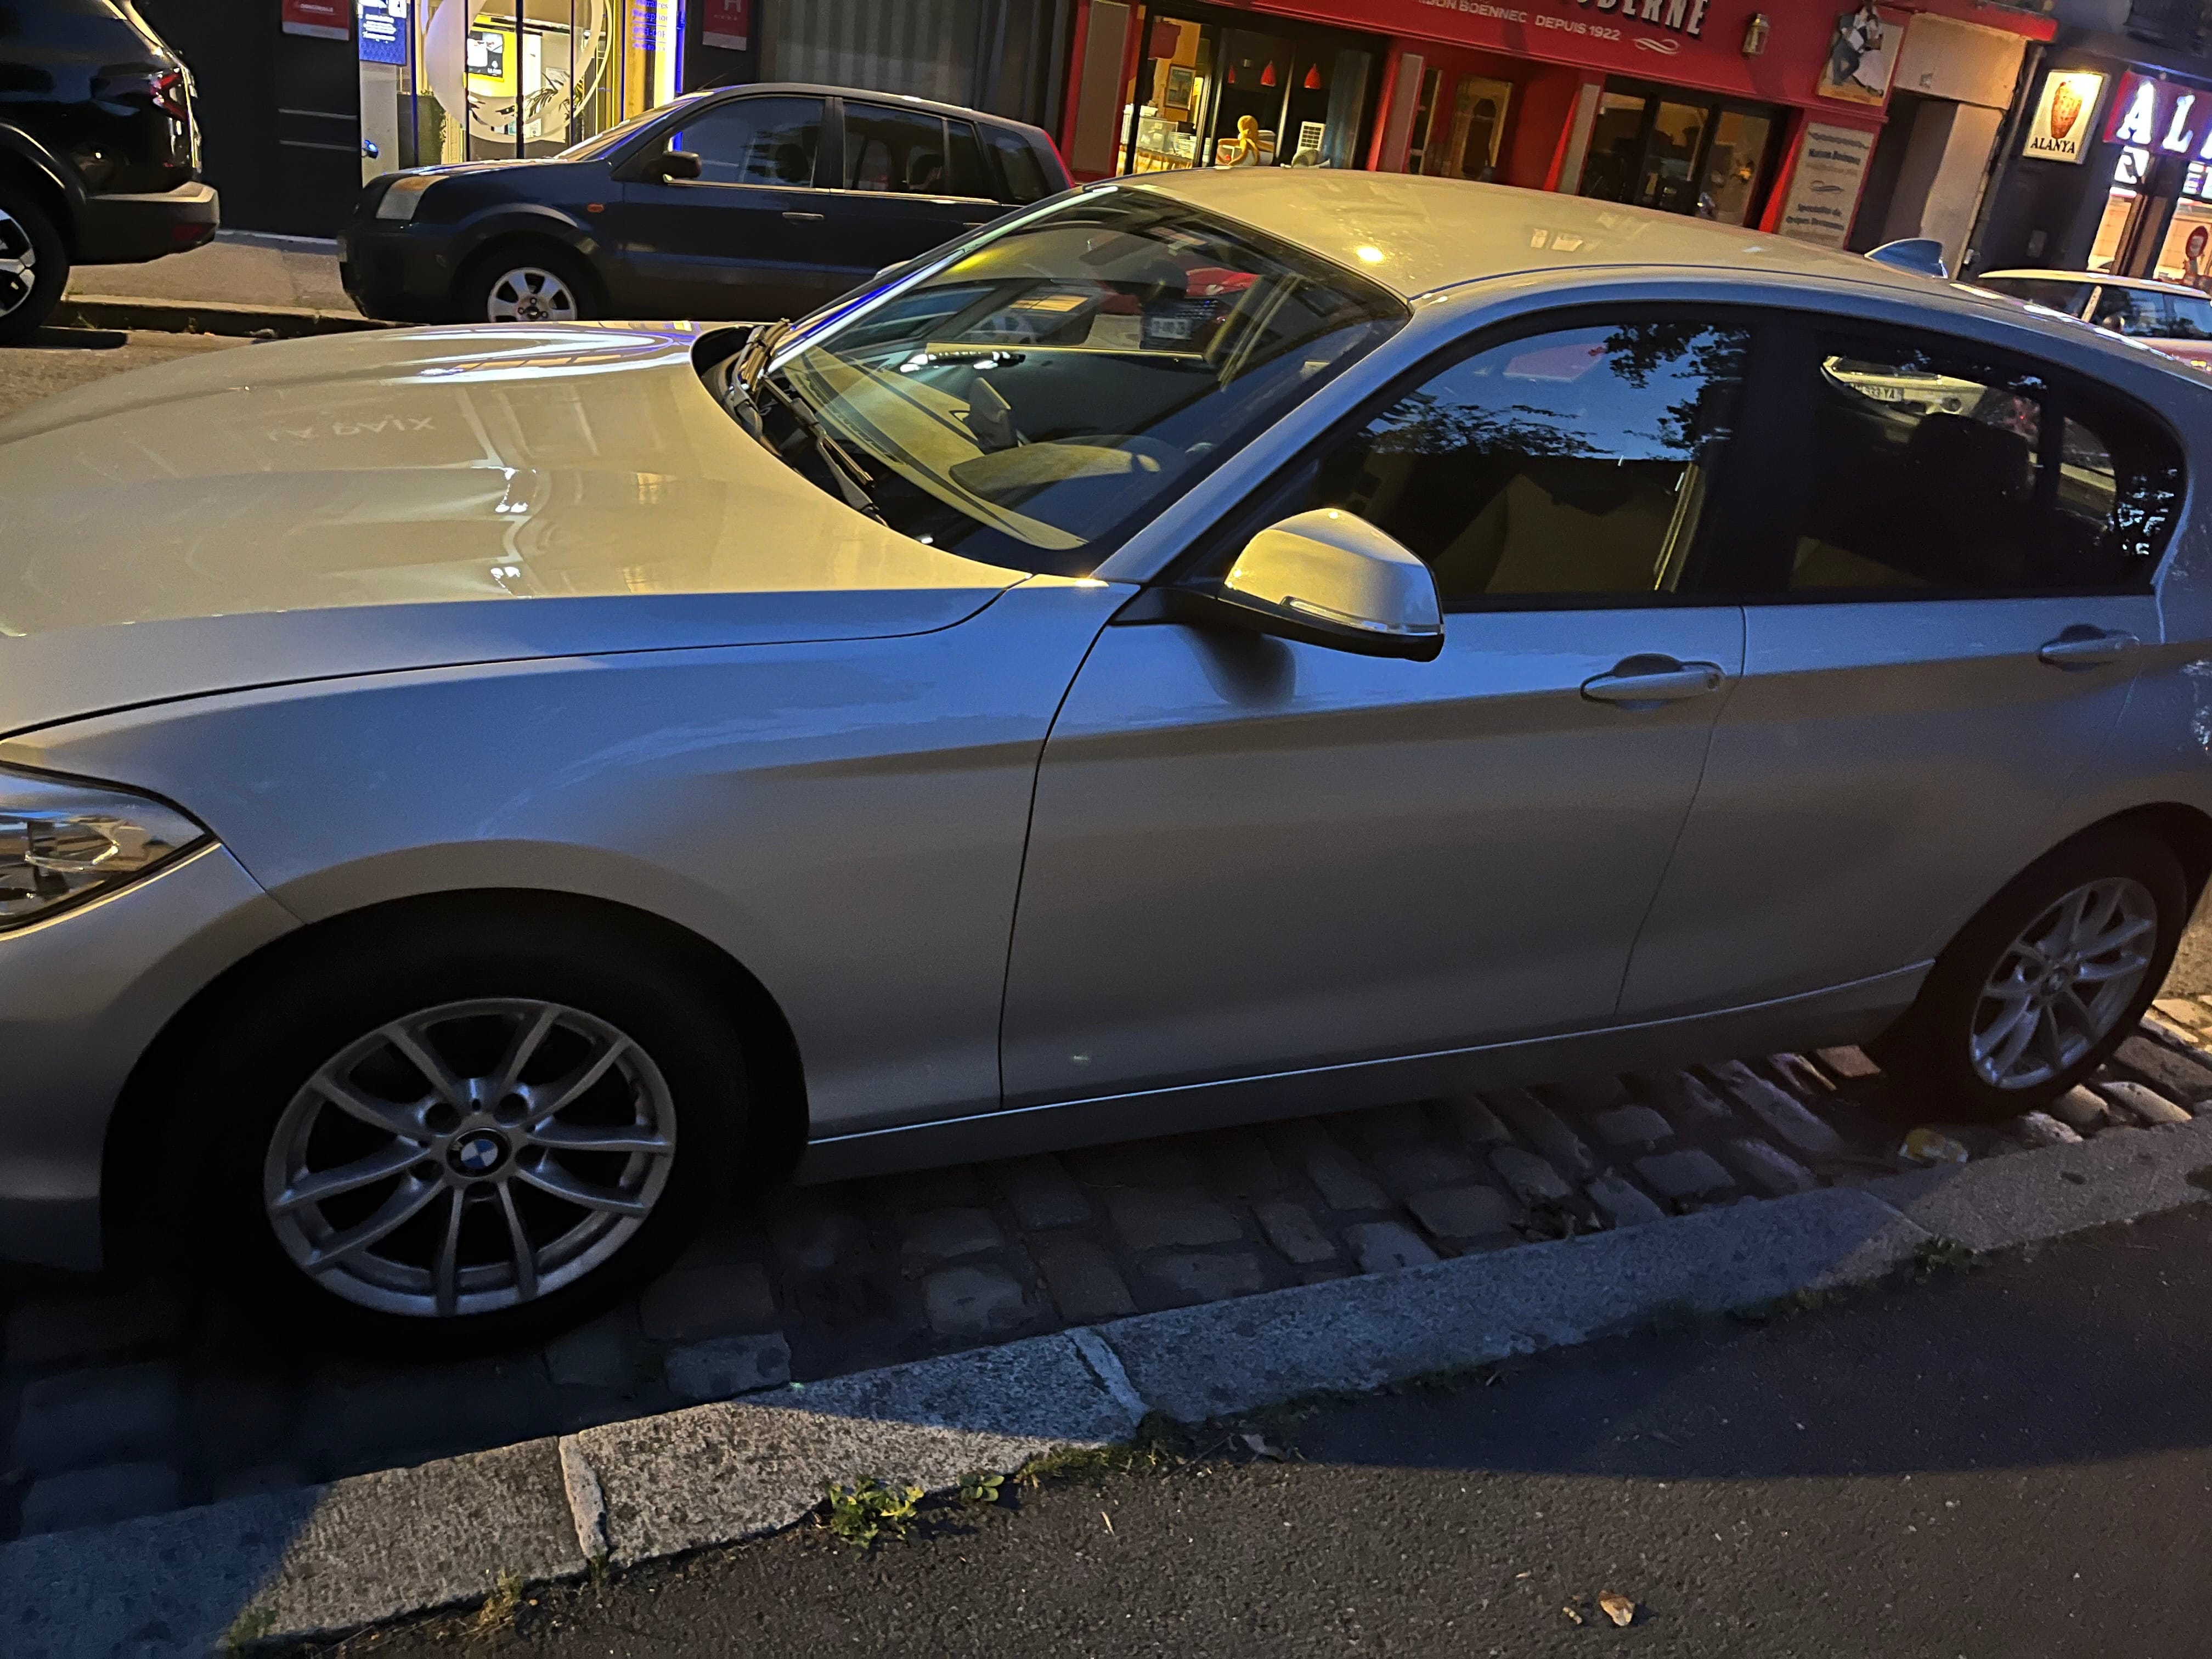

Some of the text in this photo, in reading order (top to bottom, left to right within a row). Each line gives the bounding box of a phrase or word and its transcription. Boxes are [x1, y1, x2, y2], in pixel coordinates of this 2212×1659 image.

[1459, 0, 1528, 23] BOENNEC
[1535, 14, 1587, 35] DEPUIS
[1590, 25, 1621, 41] 1922
[2116, 80, 2212, 159] AL
[2030, 137, 2075, 154] ALANYA
